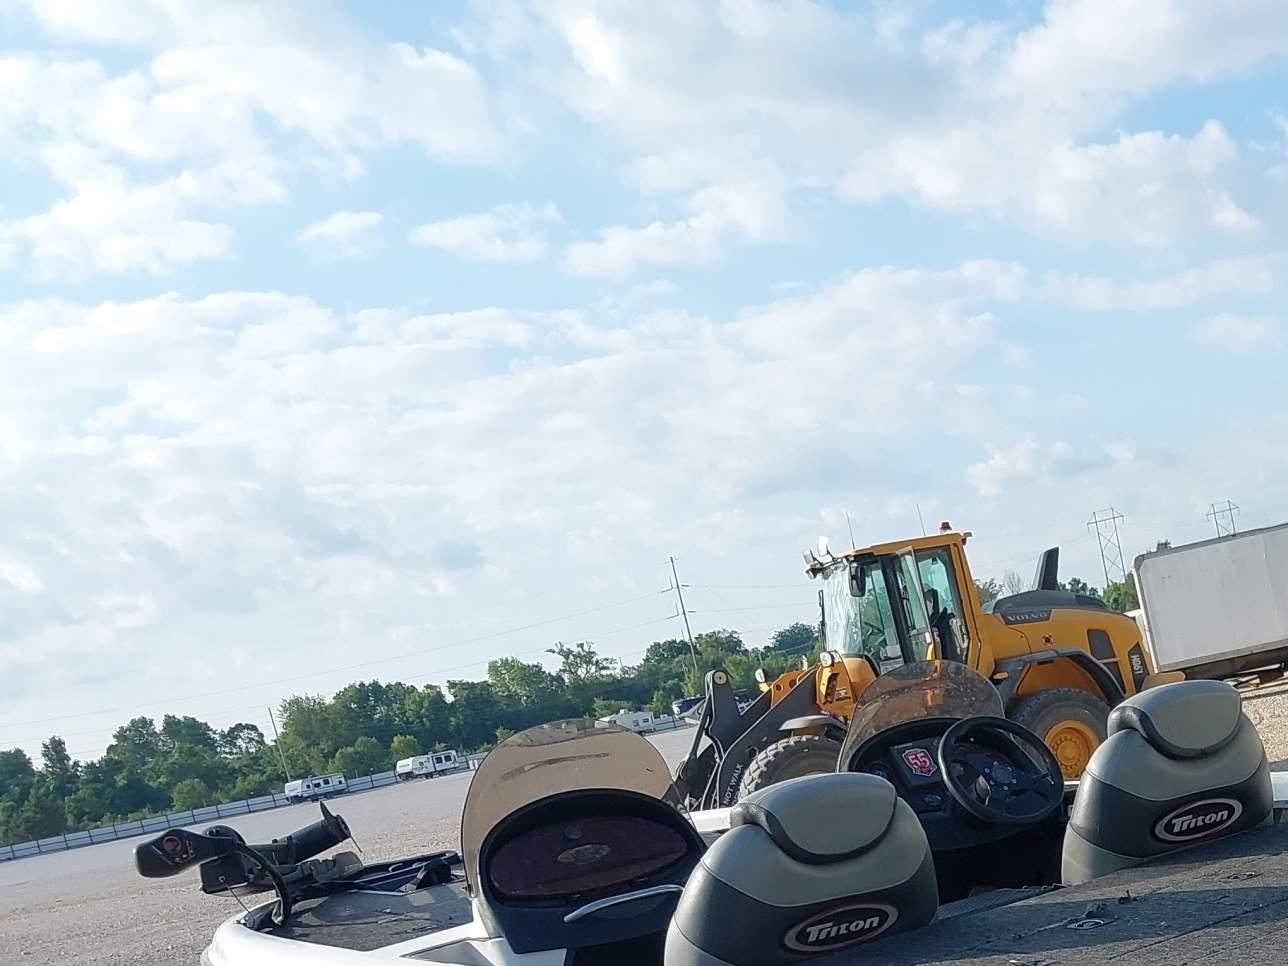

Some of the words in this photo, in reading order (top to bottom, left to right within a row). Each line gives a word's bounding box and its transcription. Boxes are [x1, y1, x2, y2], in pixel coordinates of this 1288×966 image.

[1007, 611, 1047, 621] VOLVO
[907, 752, 931, 769] 55
[730, 762, 744, 786] WALK
[1171, 810, 1229, 833] Triton
[806, 916, 880, 942] Triton
